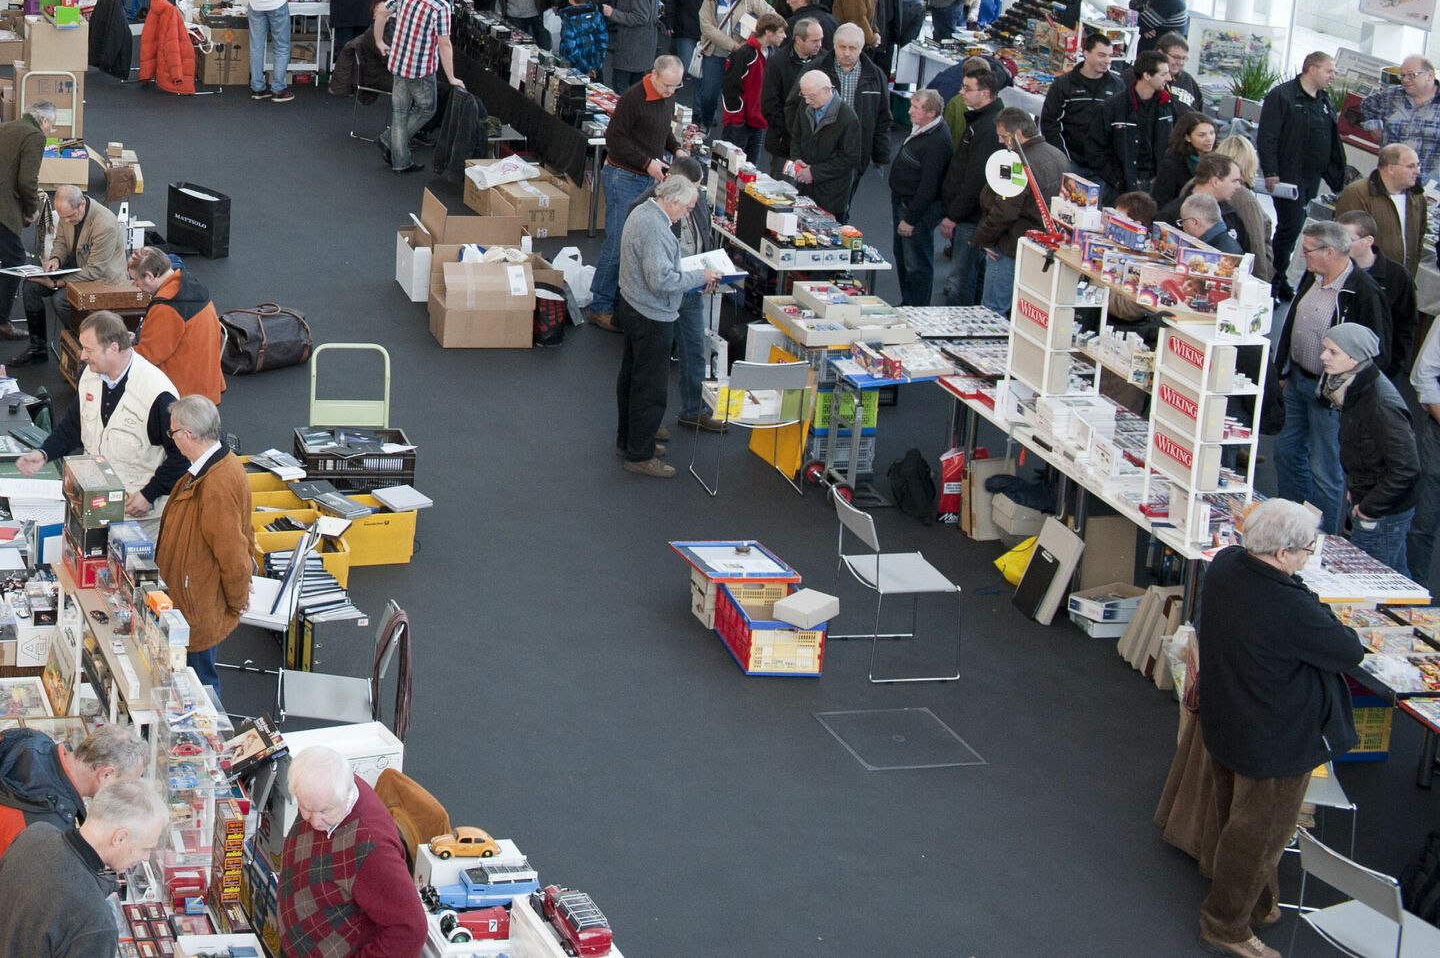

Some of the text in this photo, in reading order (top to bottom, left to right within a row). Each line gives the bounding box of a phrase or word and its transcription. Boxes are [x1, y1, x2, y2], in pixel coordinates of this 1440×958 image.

[1162, 384, 1197, 419] WIKING
[1157, 432, 1192, 466] WIKING
[490, 922, 496, 930] 7
